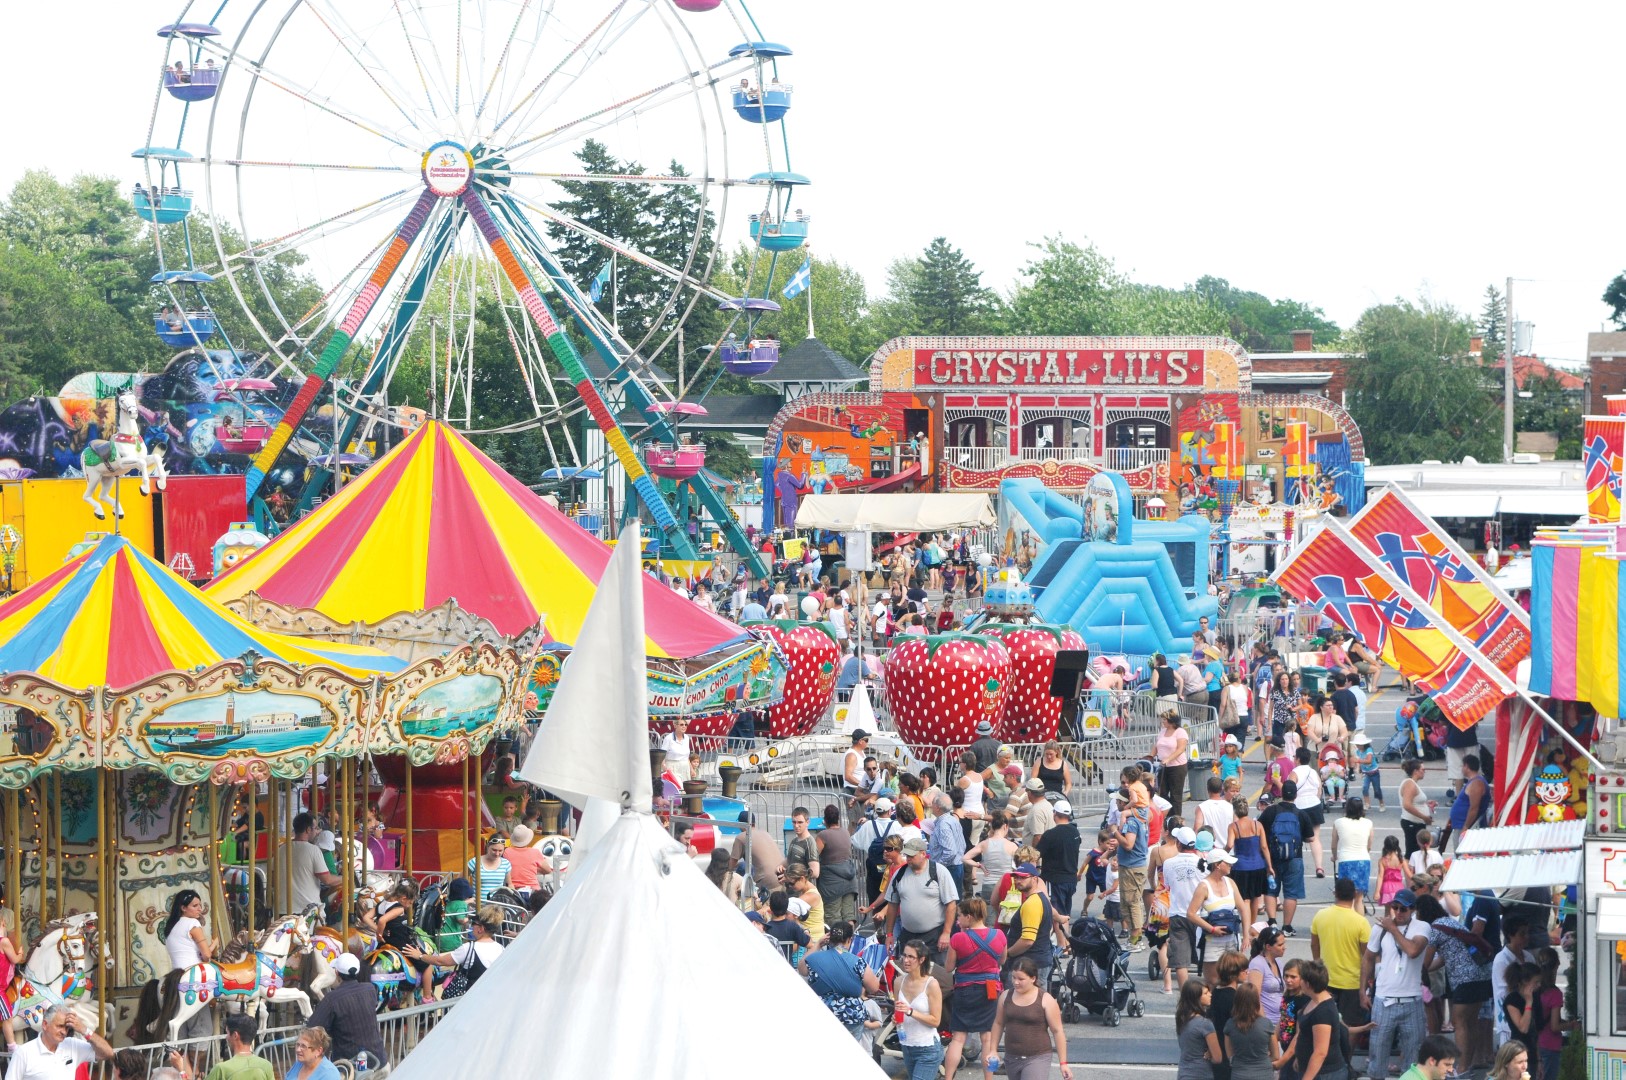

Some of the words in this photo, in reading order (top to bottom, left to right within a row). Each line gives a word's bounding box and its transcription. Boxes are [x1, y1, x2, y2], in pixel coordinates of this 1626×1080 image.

[930, 350, 1087, 384] CRYSTAL
[1102, 350, 1188, 384] LIL'S
[649, 694, 681, 707] JOLLY
[686, 689, 706, 706] CHOO
[710, 673, 729, 693] CHOO
